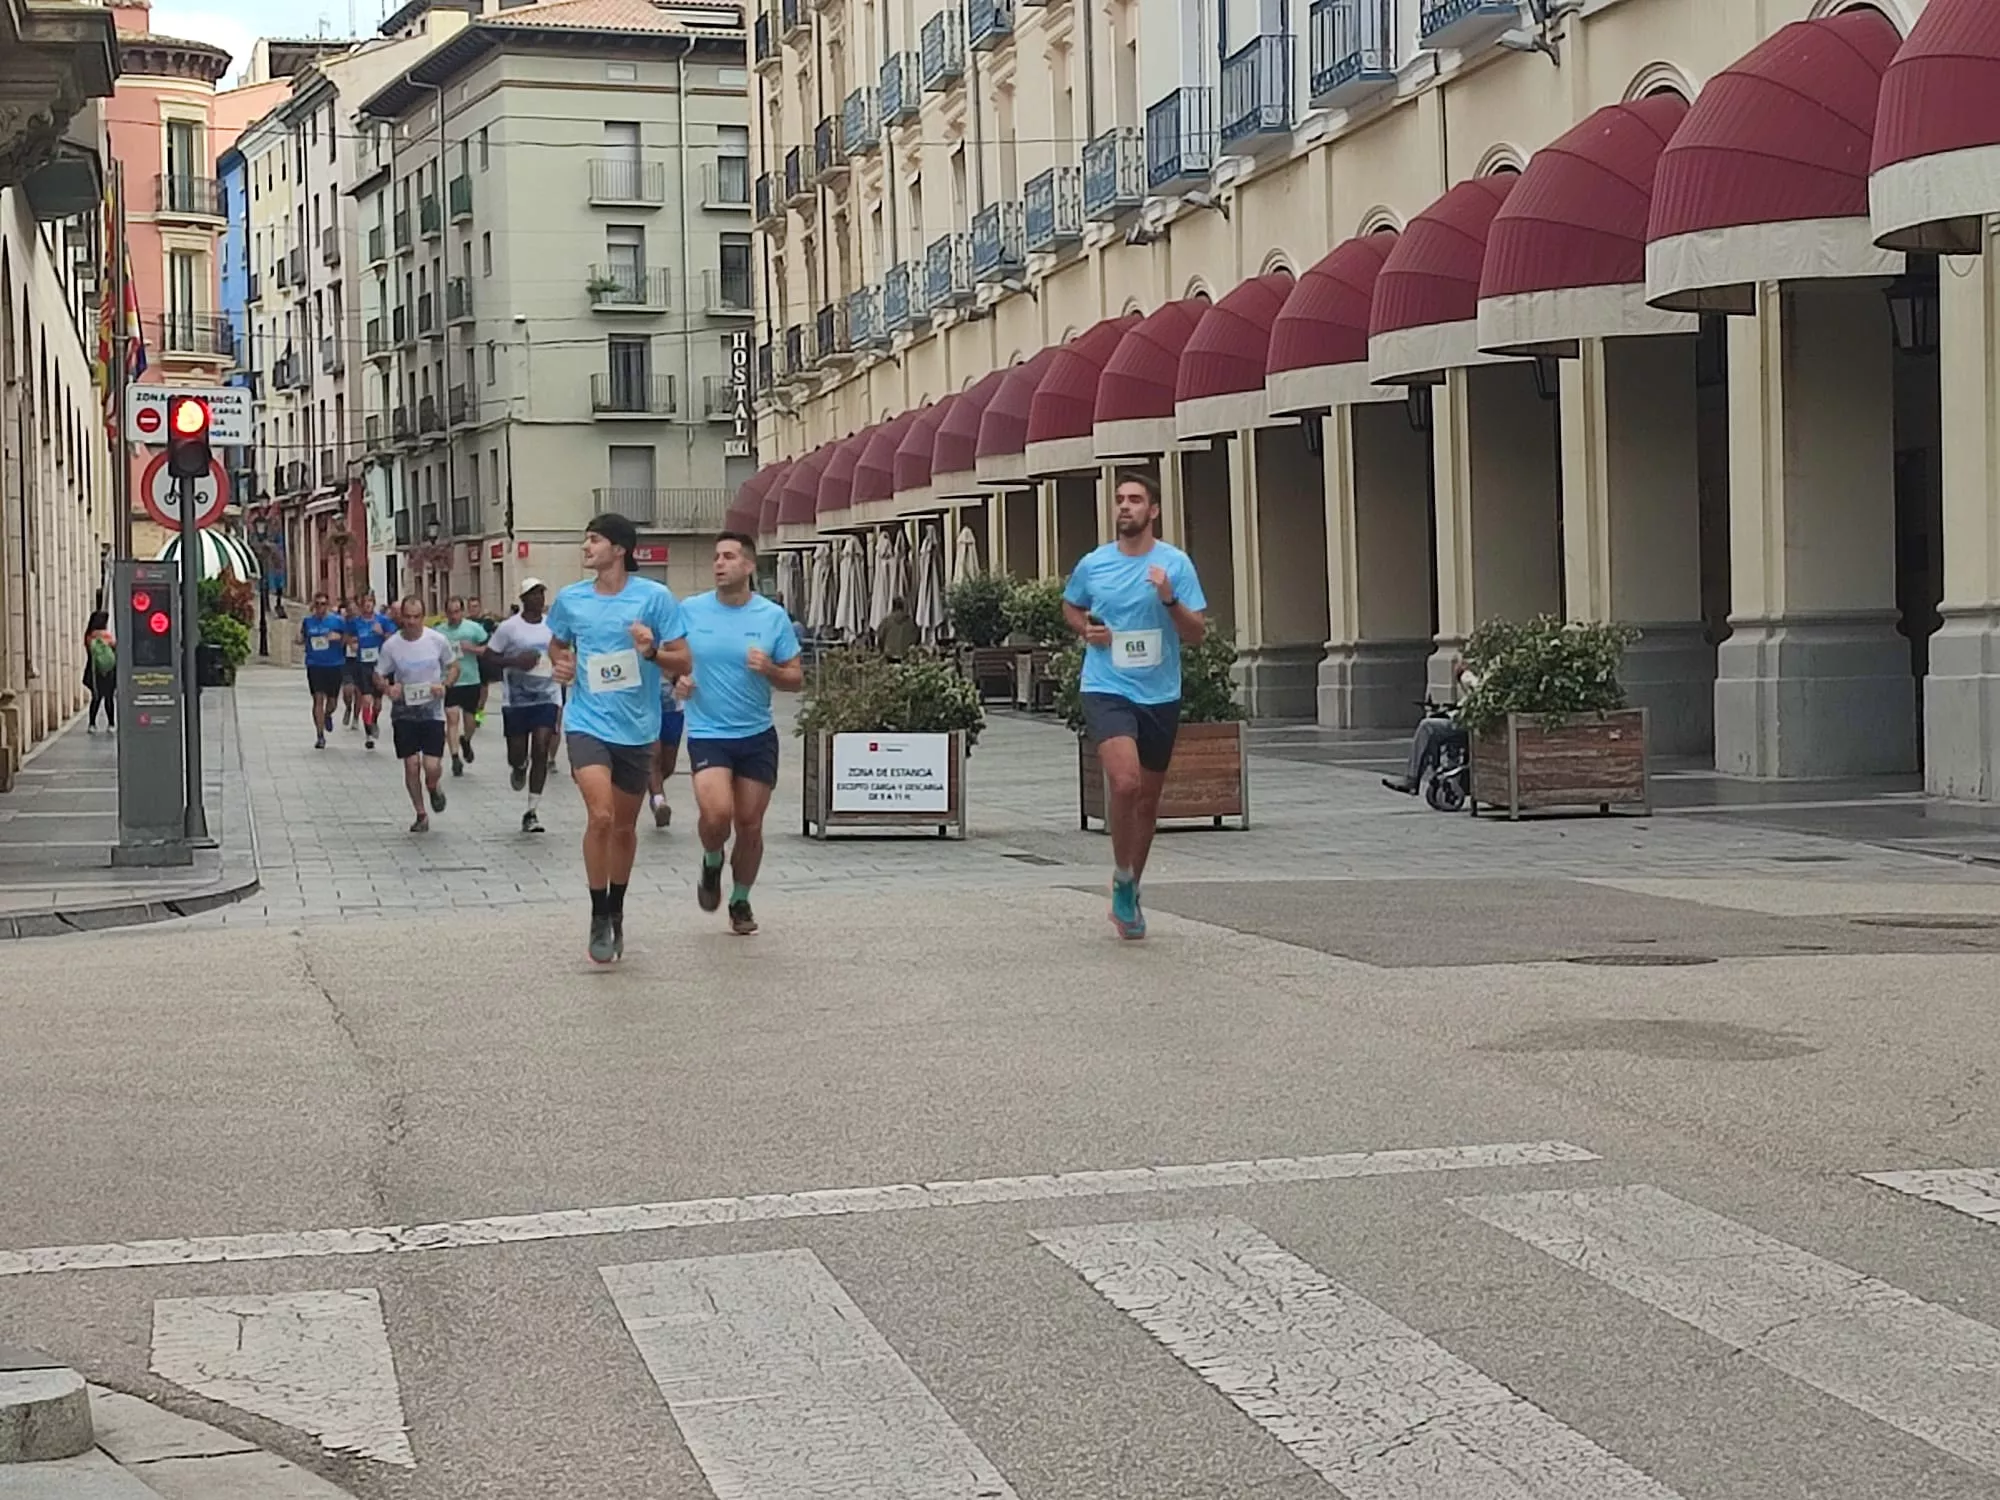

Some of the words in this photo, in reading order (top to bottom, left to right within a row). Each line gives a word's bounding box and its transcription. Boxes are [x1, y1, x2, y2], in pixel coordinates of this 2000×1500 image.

[733, 331, 748, 436] HOSTAL
[136, 392, 167, 401] ZONA
[1125, 640, 1146, 652] 68
[601, 664, 622, 679] 69
[848, 767, 873, 777] ZONA
[876, 768, 888, 777] DE
[871, 783, 896, 791] CARGA
[905, 783, 944, 791] DESCARGA
[868, 792, 878, 800] DE
